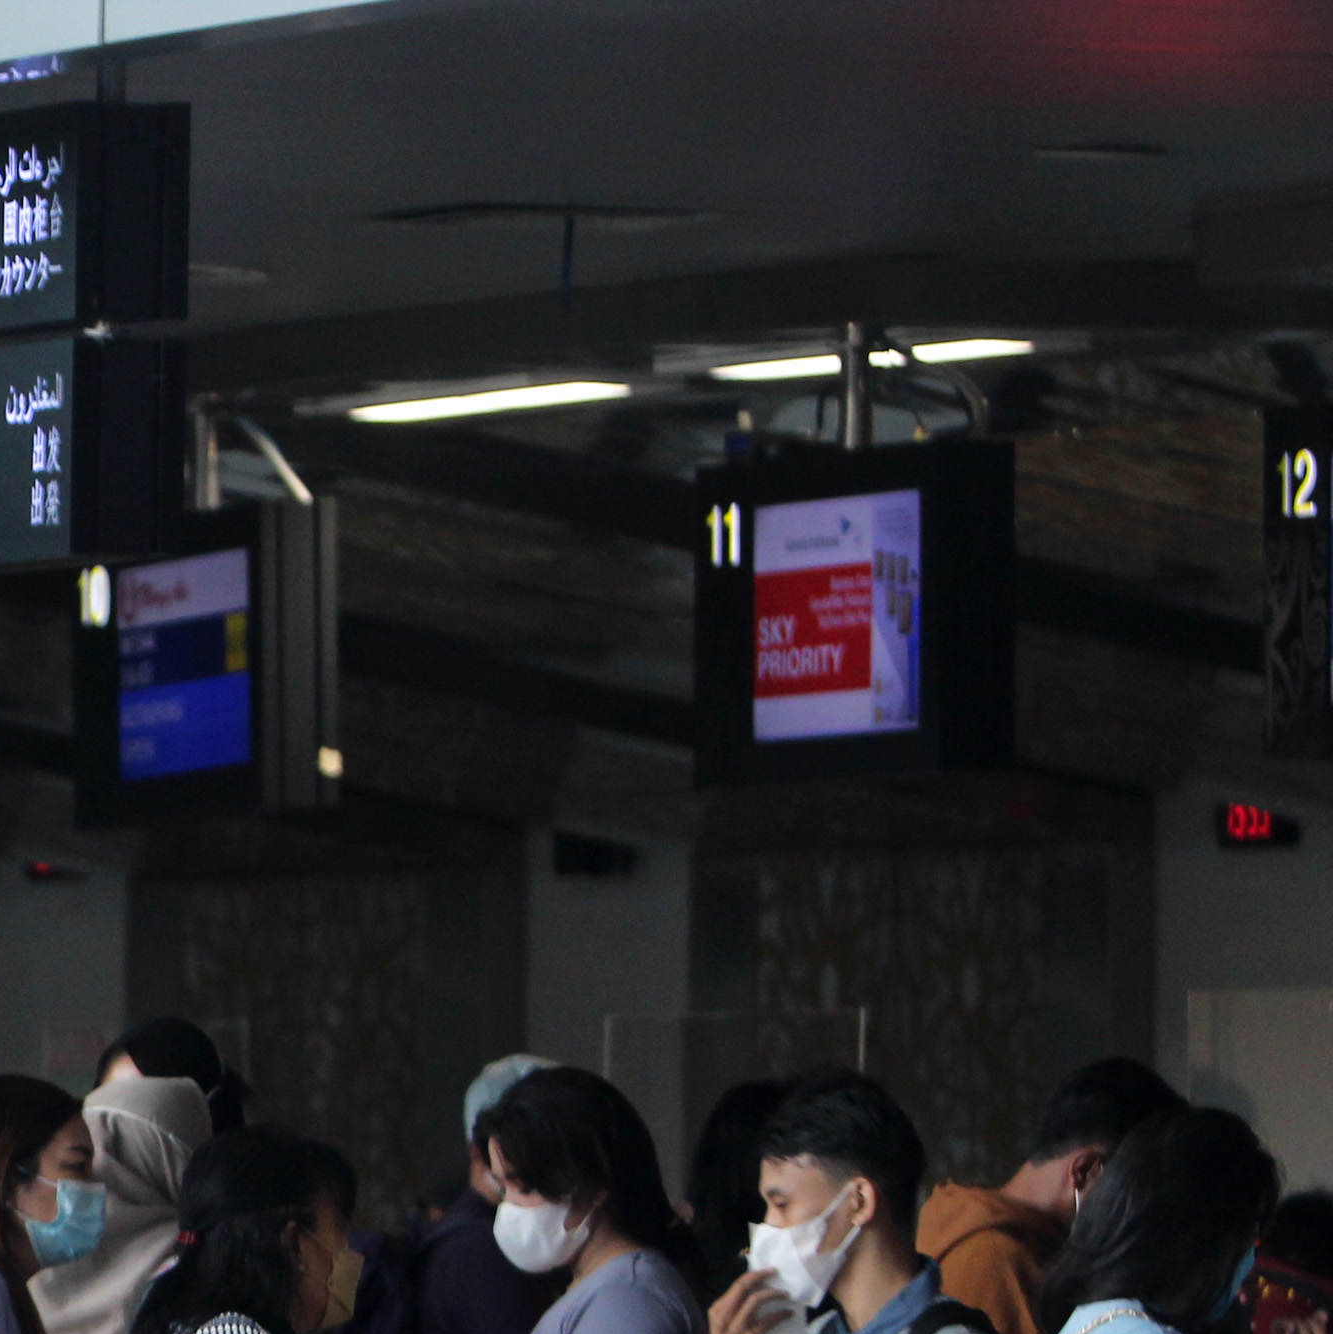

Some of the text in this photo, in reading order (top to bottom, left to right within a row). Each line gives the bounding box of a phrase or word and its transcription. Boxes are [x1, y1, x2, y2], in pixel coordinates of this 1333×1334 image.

[32, 424, 62, 474] 出发
[1278, 447, 1316, 519] 12
[707, 502, 741, 568] 11
[758, 614, 796, 646] SKY
[758, 643, 844, 681] PRIORITY
